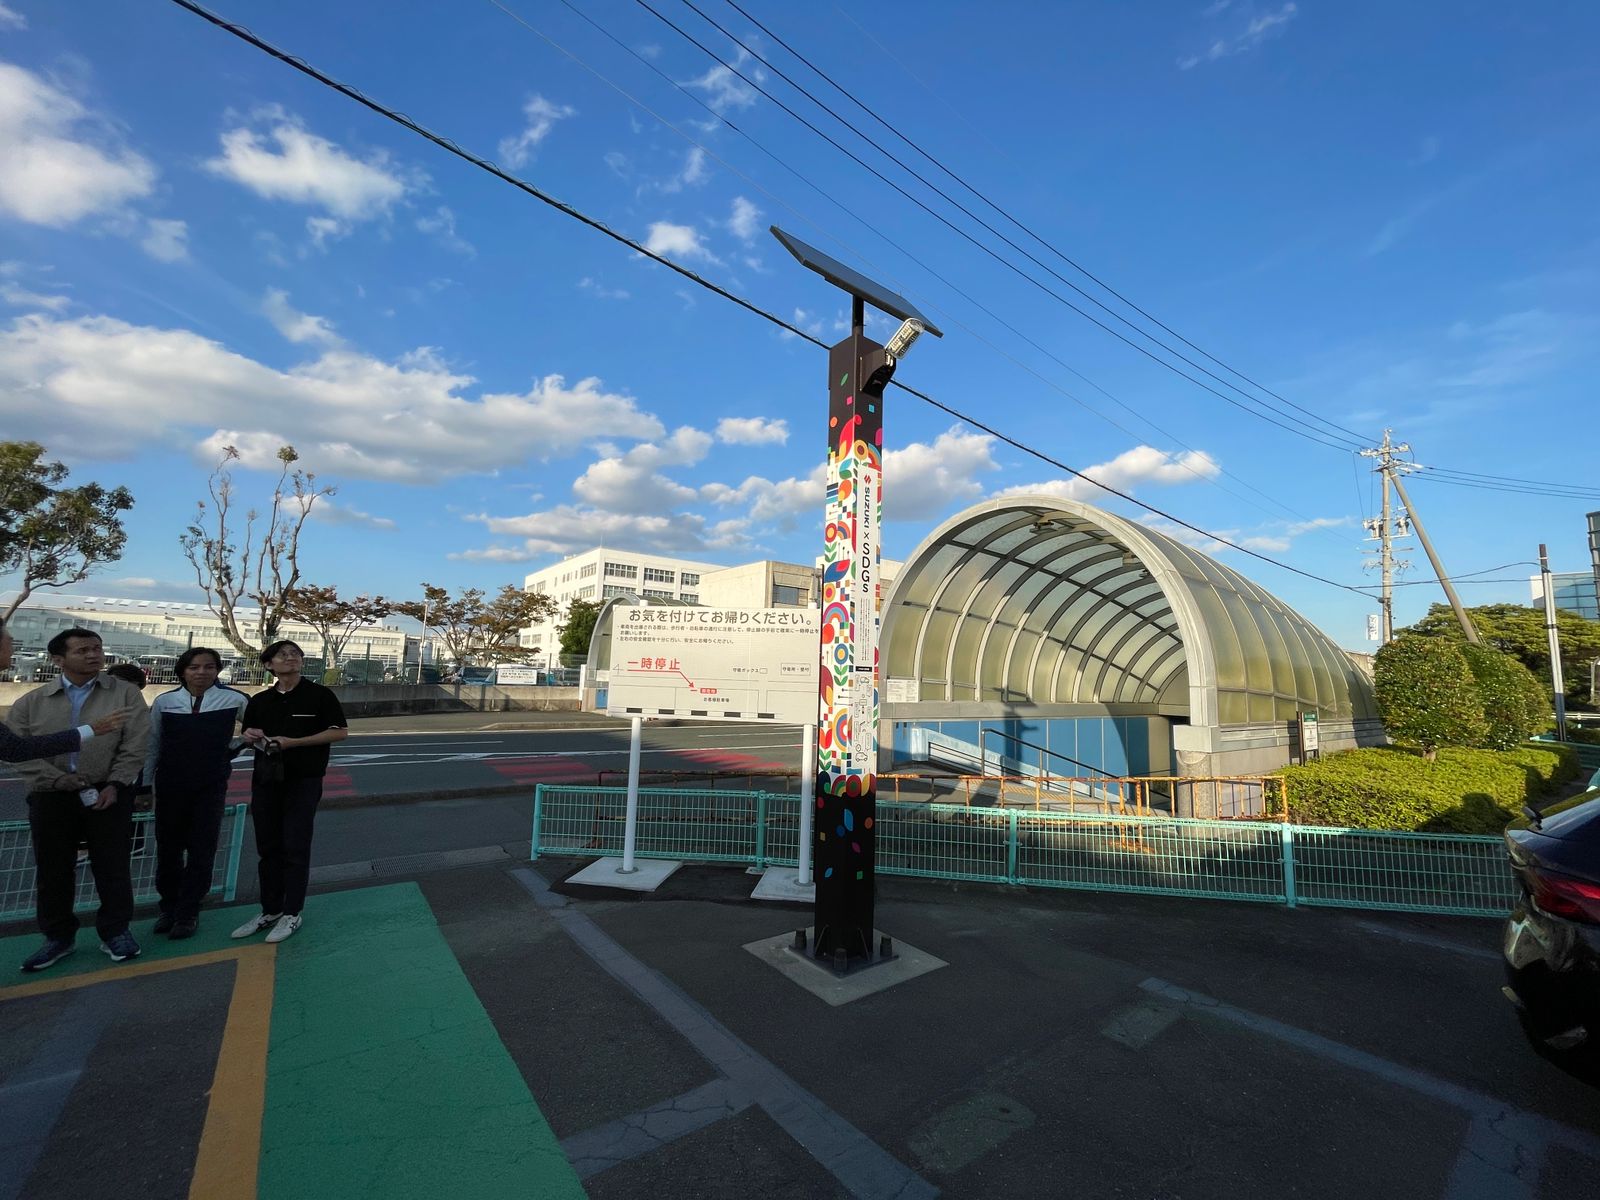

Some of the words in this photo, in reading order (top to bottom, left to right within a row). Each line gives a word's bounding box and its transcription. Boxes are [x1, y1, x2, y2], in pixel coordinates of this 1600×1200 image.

[863, 486, 871, 528] SUZUKI
[861, 542, 871, 593] SDGs
[629, 609, 813, 626] お気を付けてお帰りください。
[627, 657, 681, 670] 一時停止
